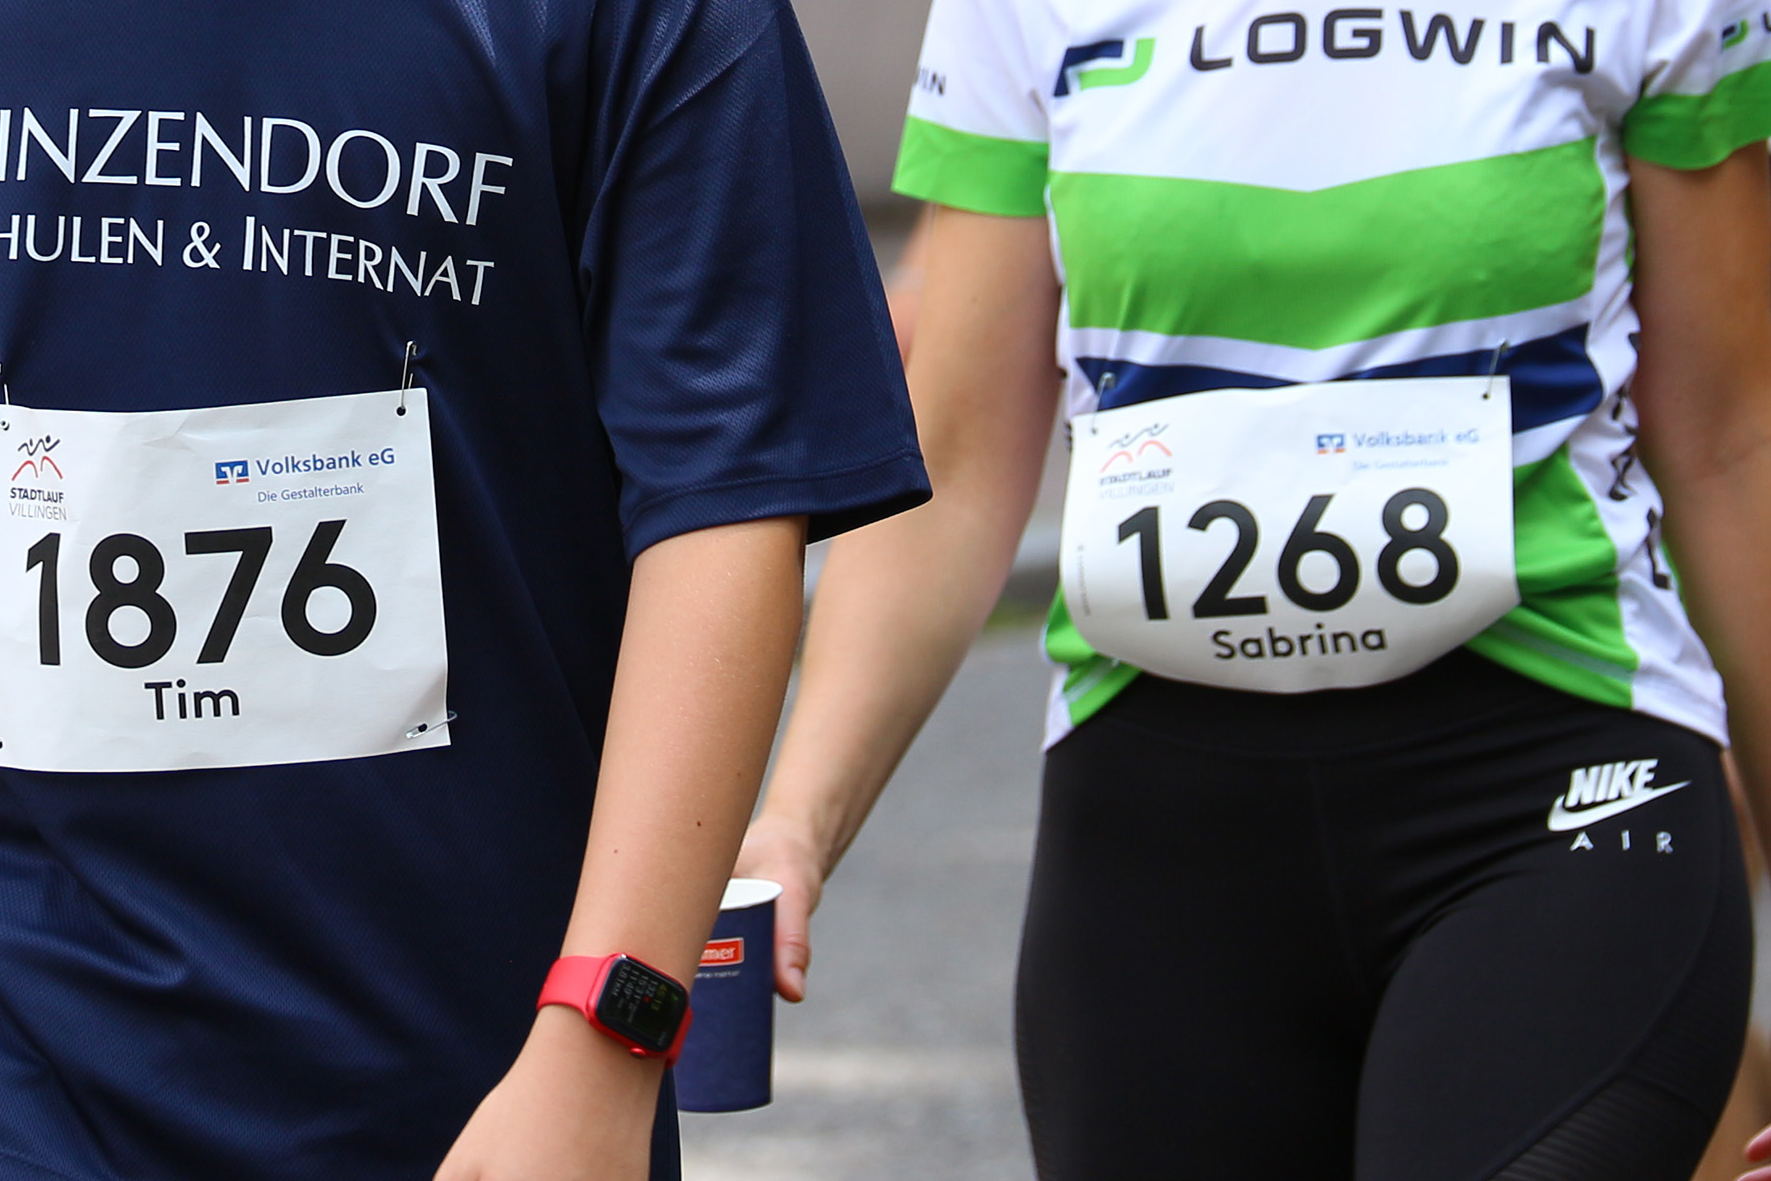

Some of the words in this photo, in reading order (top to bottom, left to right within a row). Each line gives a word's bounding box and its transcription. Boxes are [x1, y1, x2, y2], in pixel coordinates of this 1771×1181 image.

[1189, 7, 1596, 75] LOGWIN
[181, 220, 221, 270] &
[242, 215, 495, 306] INTERNAT
[1352, 431, 1448, 448] Volksbank
[255, 450, 363, 477] Volksbank
[368, 448, 396, 466] eG
[8, 502, 67, 520] VILLINGEN
[9, 486, 65, 504] STADTLAUF
[257, 489, 278, 503] Die
[280, 483, 364, 501] Gestalterbank
[1117, 486, 1460, 621] 1268
[25, 518, 378, 670] 1876
[1211, 623, 1387, 661] Sabrina
[144, 678, 241, 720] Tim
[1564, 758, 1659, 808] NIKE
[1569, 830, 1673, 854] AIR
